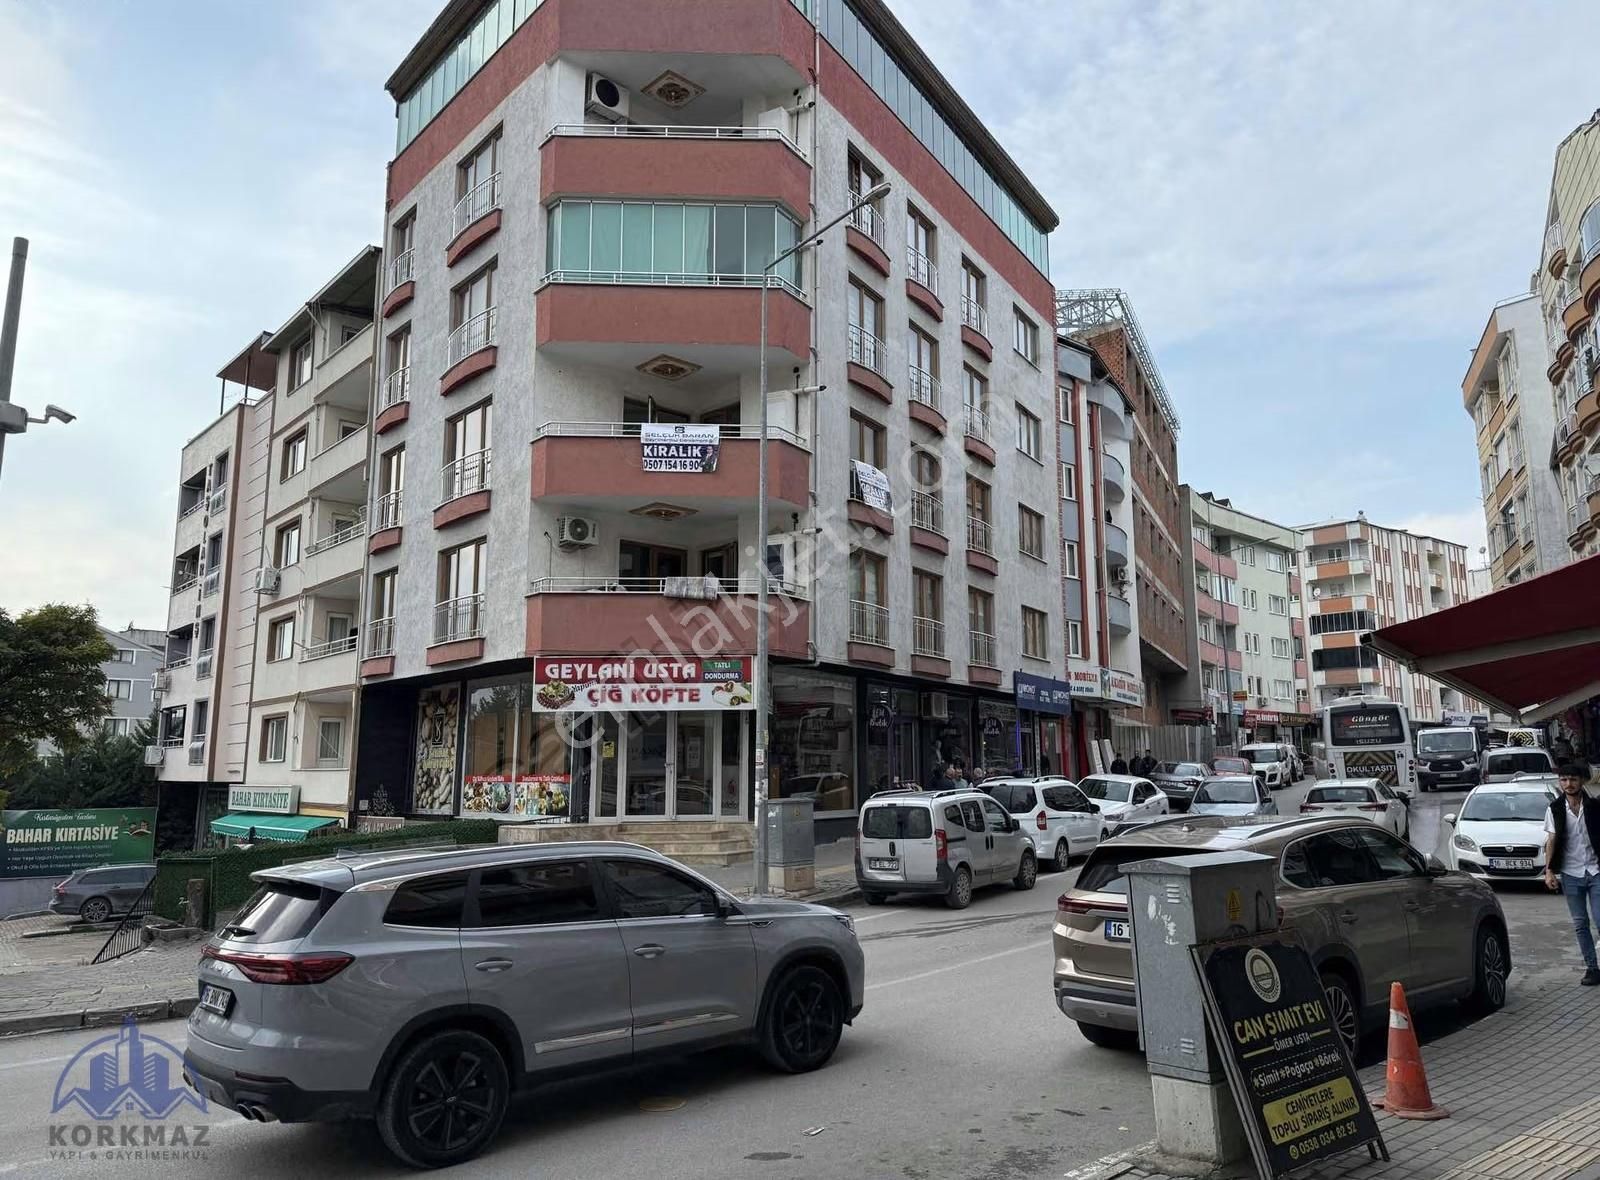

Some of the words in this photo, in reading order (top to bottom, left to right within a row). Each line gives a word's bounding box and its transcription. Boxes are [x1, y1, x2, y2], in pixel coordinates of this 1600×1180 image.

[643, 445, 702, 458] KİRALIK
[643, 459, 662, 470] 0507
[664, 460, 678, 470] 154
[680, 460, 688, 470] 16
[689, 460, 699, 470] 90
[545, 660, 635, 680] GEYLANİ
[643, 662, 696, 680] USTA
[704, 671, 740, 680] DONDURMA
[587, 685, 622, 707] ÇİĞ
[631, 685, 701, 703] KÖFTE
[1351, 714, 1390, 722] Güngör
[231, 790, 252, 806] BAHAR
[252, 789, 289, 809] KIRTASİYE
[6, 828, 52, 844] BAHAR
[56, 823, 119, 842] KIRTASİYE
[1112, 923, 1124, 937] 16
[1234, 1016, 1267, 1044] CAN
[1264, 1003, 1304, 1035] SİMİT
[1302, 1000, 1326, 1023] EVİ
[1274, 1037, 1295, 1051] ÖMER
[1294, 1031, 1311, 1046] USTA
[1318, 1049, 1341, 1067] Börek
[1285, 1087, 1335, 1116] CEMİYETLERE
[1272, 1118, 1301, 1140] TOPLU
[1300, 1104, 1332, 1129] SİPARİŞ
[1331, 1096, 1356, 1117] ALINIR
[1299, 1136, 1320, 1154] 0538
[1319, 1130, 1336, 1146] 034
